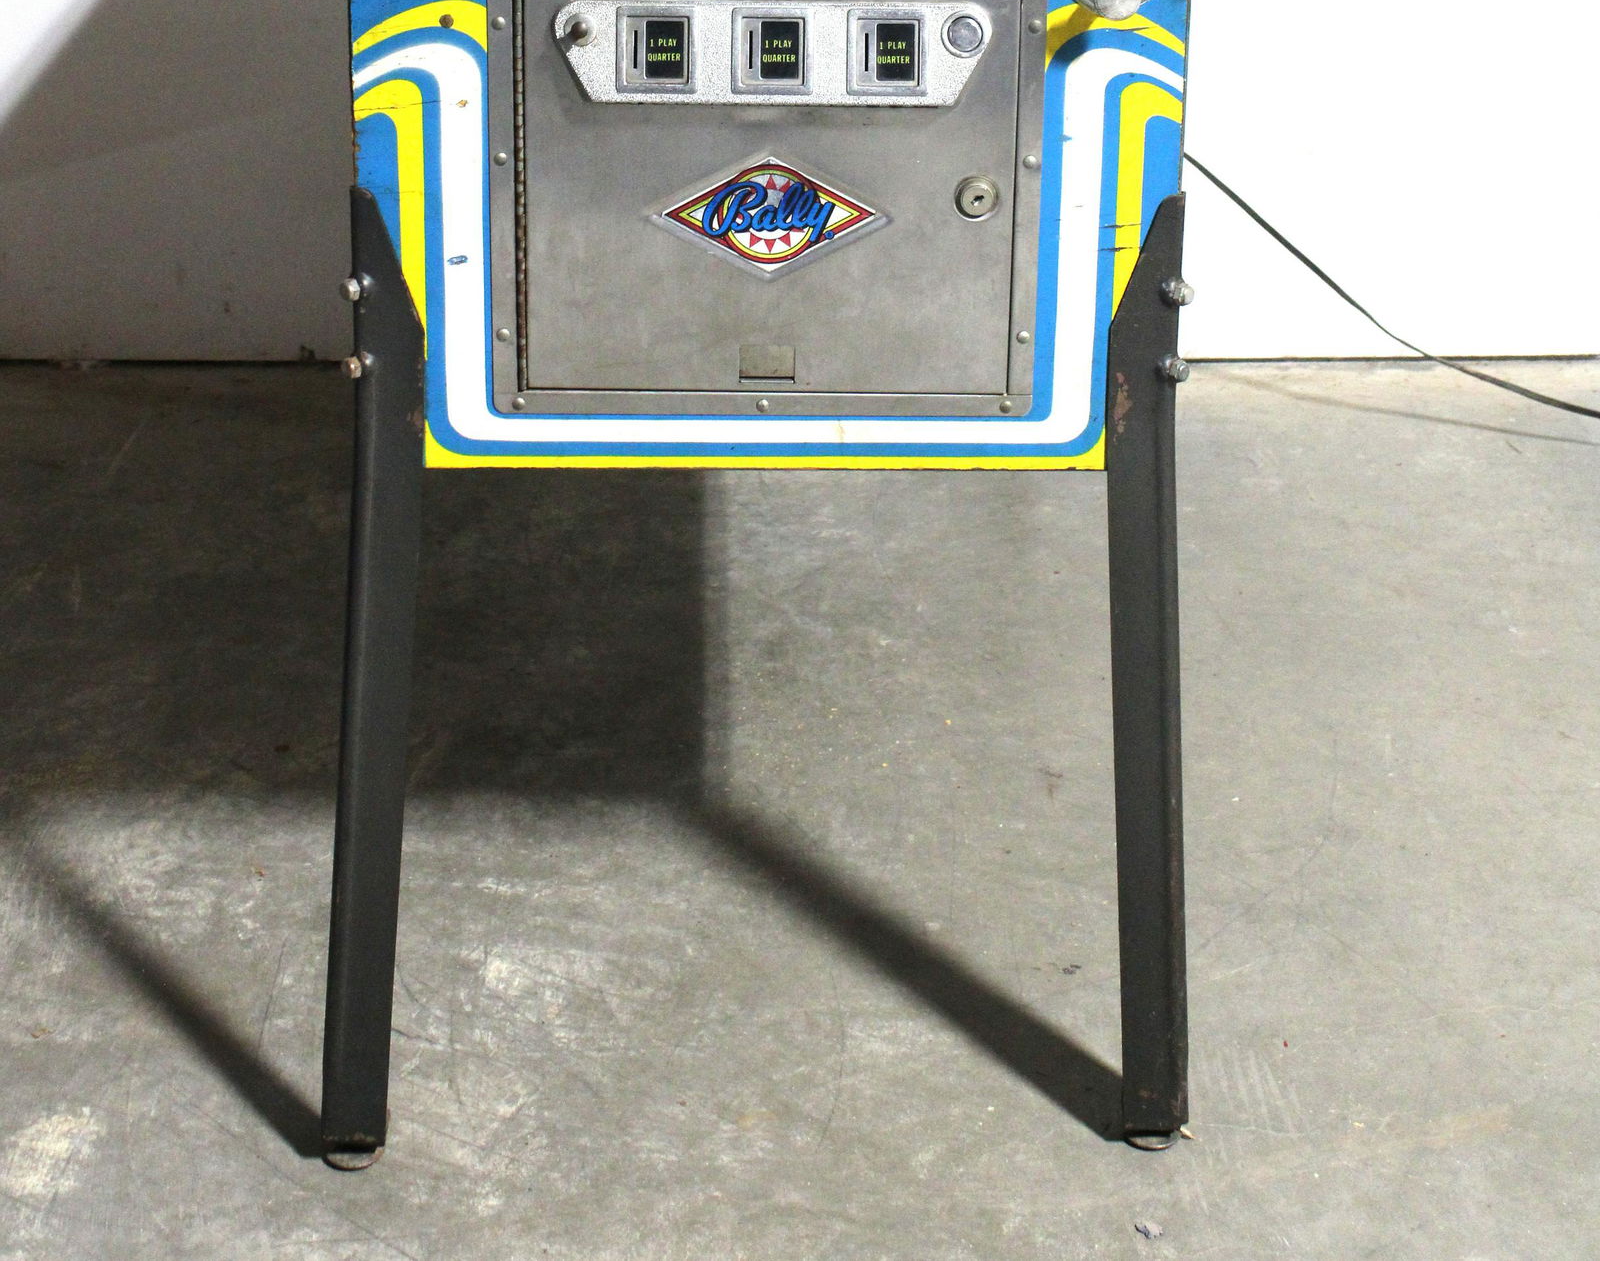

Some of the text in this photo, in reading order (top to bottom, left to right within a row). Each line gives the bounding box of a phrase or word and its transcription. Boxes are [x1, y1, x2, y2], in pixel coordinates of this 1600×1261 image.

[658, 38, 677, 47] PLAY
[773, 40, 792, 49] PLAY
[887, 41, 907, 50] PLAY
[647, 52, 681, 62] QUARTER
[762, 53, 796, 63] QUARTER
[877, 55, 911, 65] QUARTER
[702, 181, 836, 243] Bally
